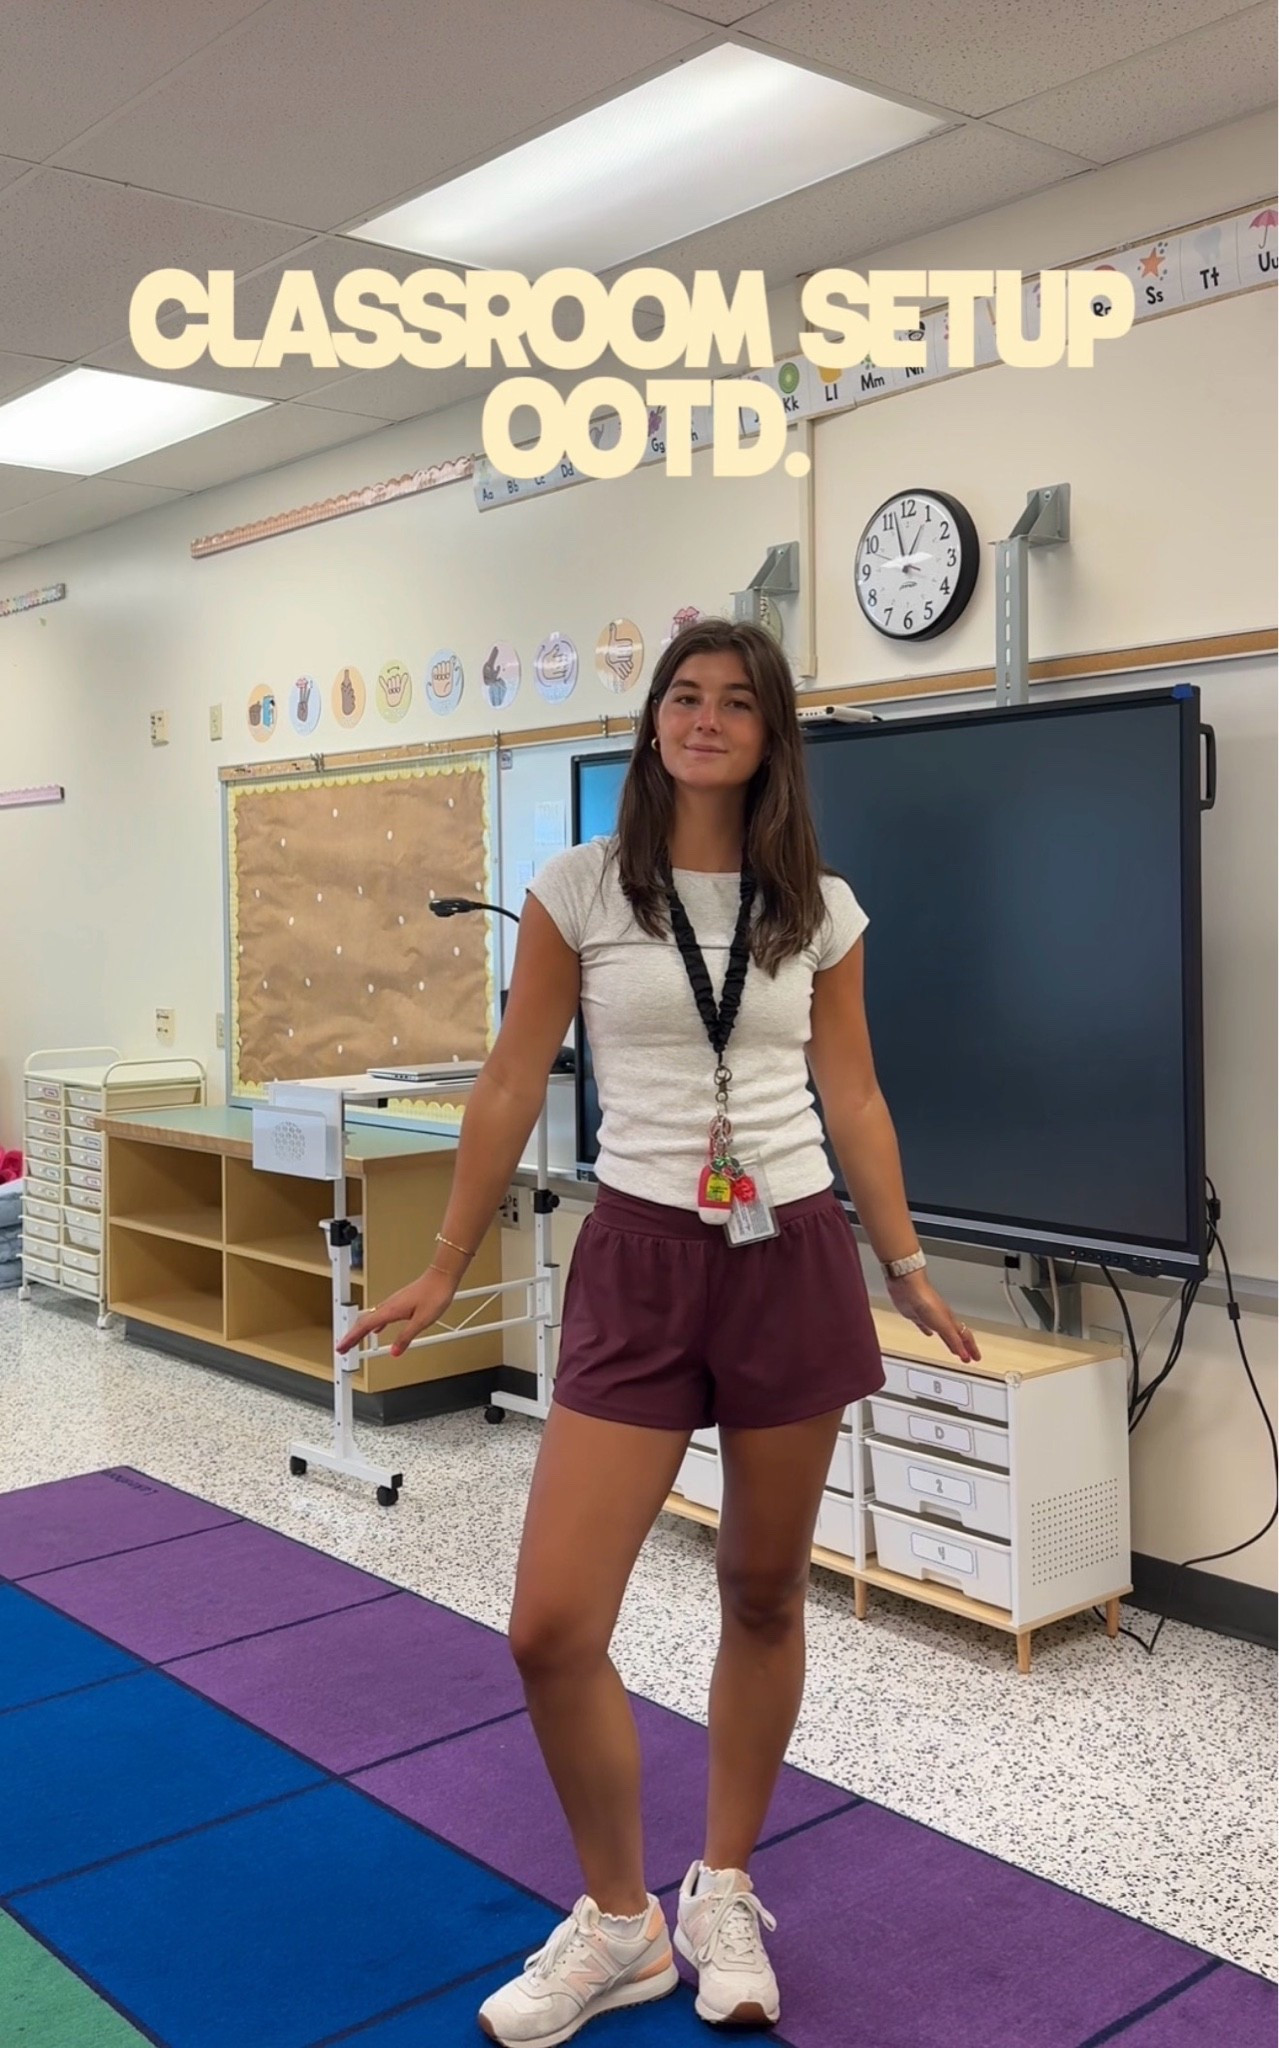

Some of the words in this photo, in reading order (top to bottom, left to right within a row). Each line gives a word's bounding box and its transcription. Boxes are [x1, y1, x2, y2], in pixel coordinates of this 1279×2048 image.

[482, 488, 495, 501] Aa
[506, 480, 520, 494] Bb
[561, 462, 575, 478] Dd
[651, 438, 666, 453] Gg
[783, 395, 800, 413] Kk
[860, 372, 885, 391] Mm
[1092, 301, 1112, 318] Rr
[1145, 286, 1164, 305] Ss
[1199, 266, 1220, 290] Tt
[901, 499, 917, 519] 12
[925, 505, 932, 522] 1
[882, 512, 895, 532] 11
[939, 521, 950, 540] 2
[865, 535, 880, 555] 10
[947, 548, 957, 567] 3
[862, 564, 871, 582] 9
[939, 576, 951, 595] 4
[867, 588, 878, 607] 8
[884, 607, 894, 626] 7
[903, 610, 913, 630] 6
[923, 601, 933, 620] 5
[933, 1380, 942, 1394] B
[935, 1425, 945, 1440] D
[935, 1478, 944, 1494] 2
